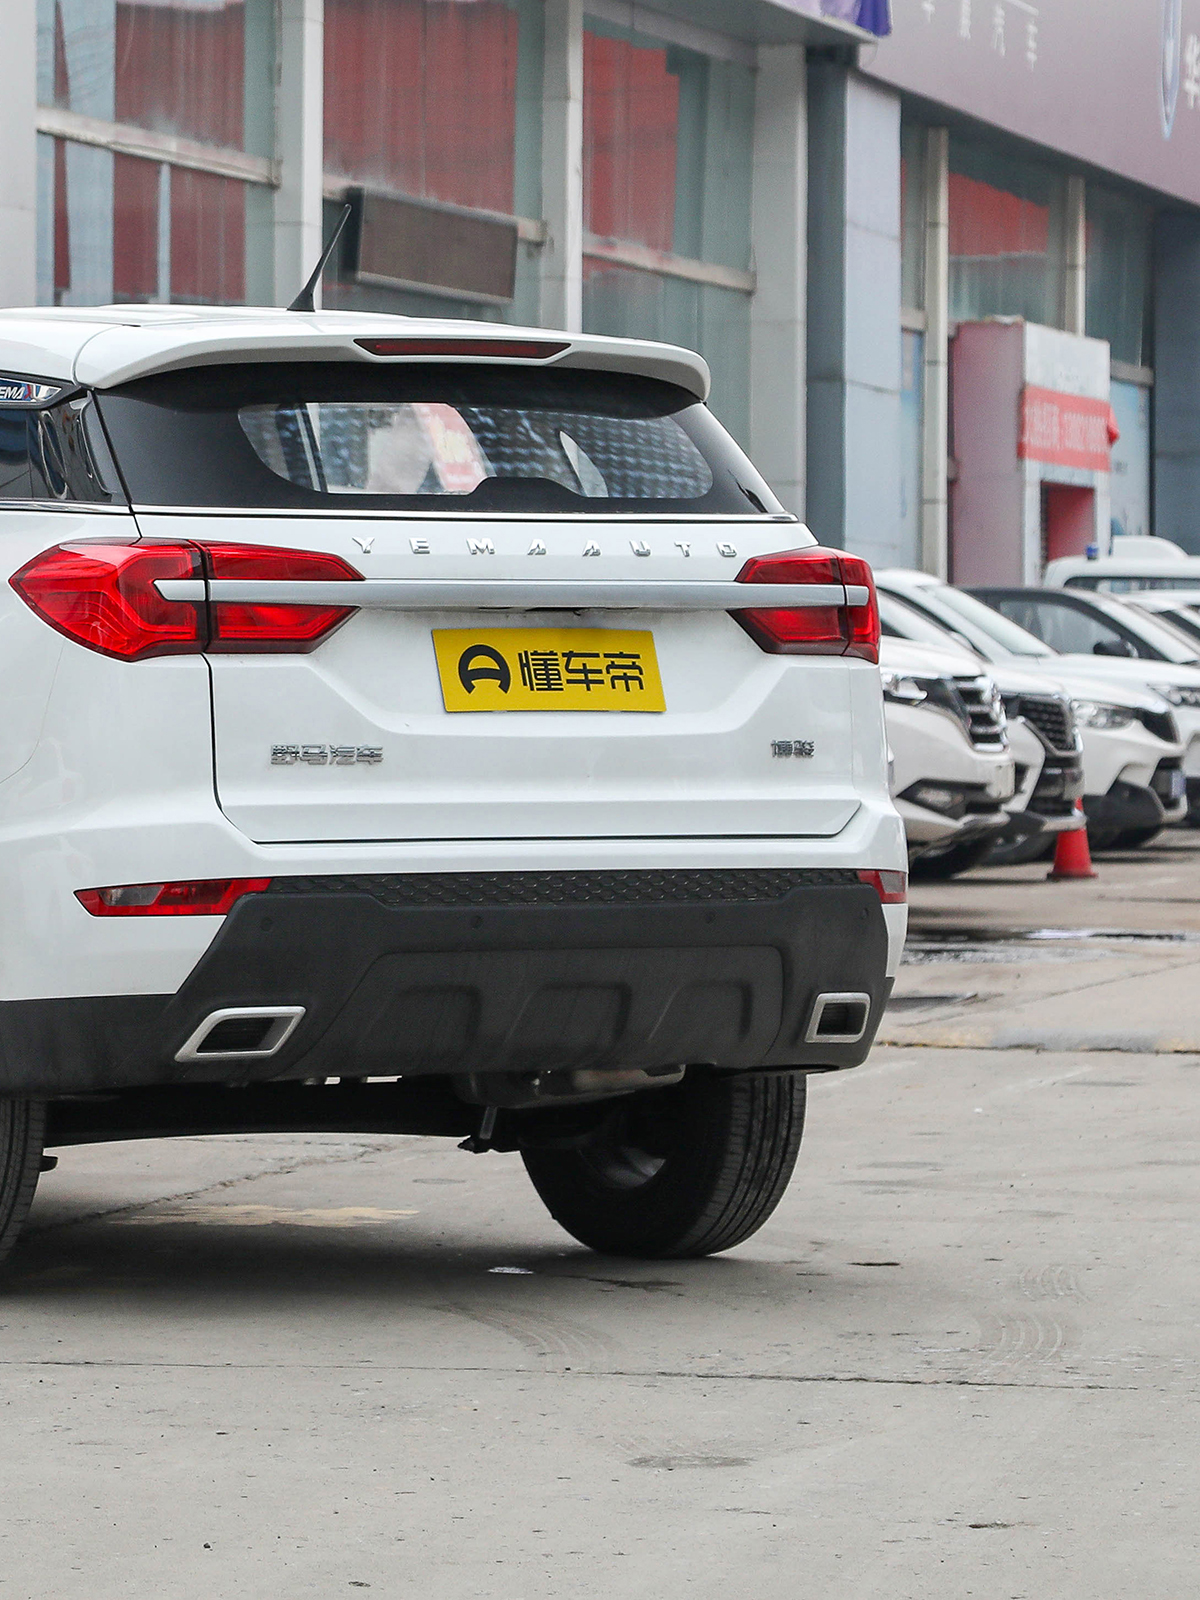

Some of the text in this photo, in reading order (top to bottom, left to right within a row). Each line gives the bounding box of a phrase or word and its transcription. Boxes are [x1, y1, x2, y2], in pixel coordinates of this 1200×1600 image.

[518, 650, 644, 692] 懂车帝
[271, 744, 384, 765] 野马汽车
